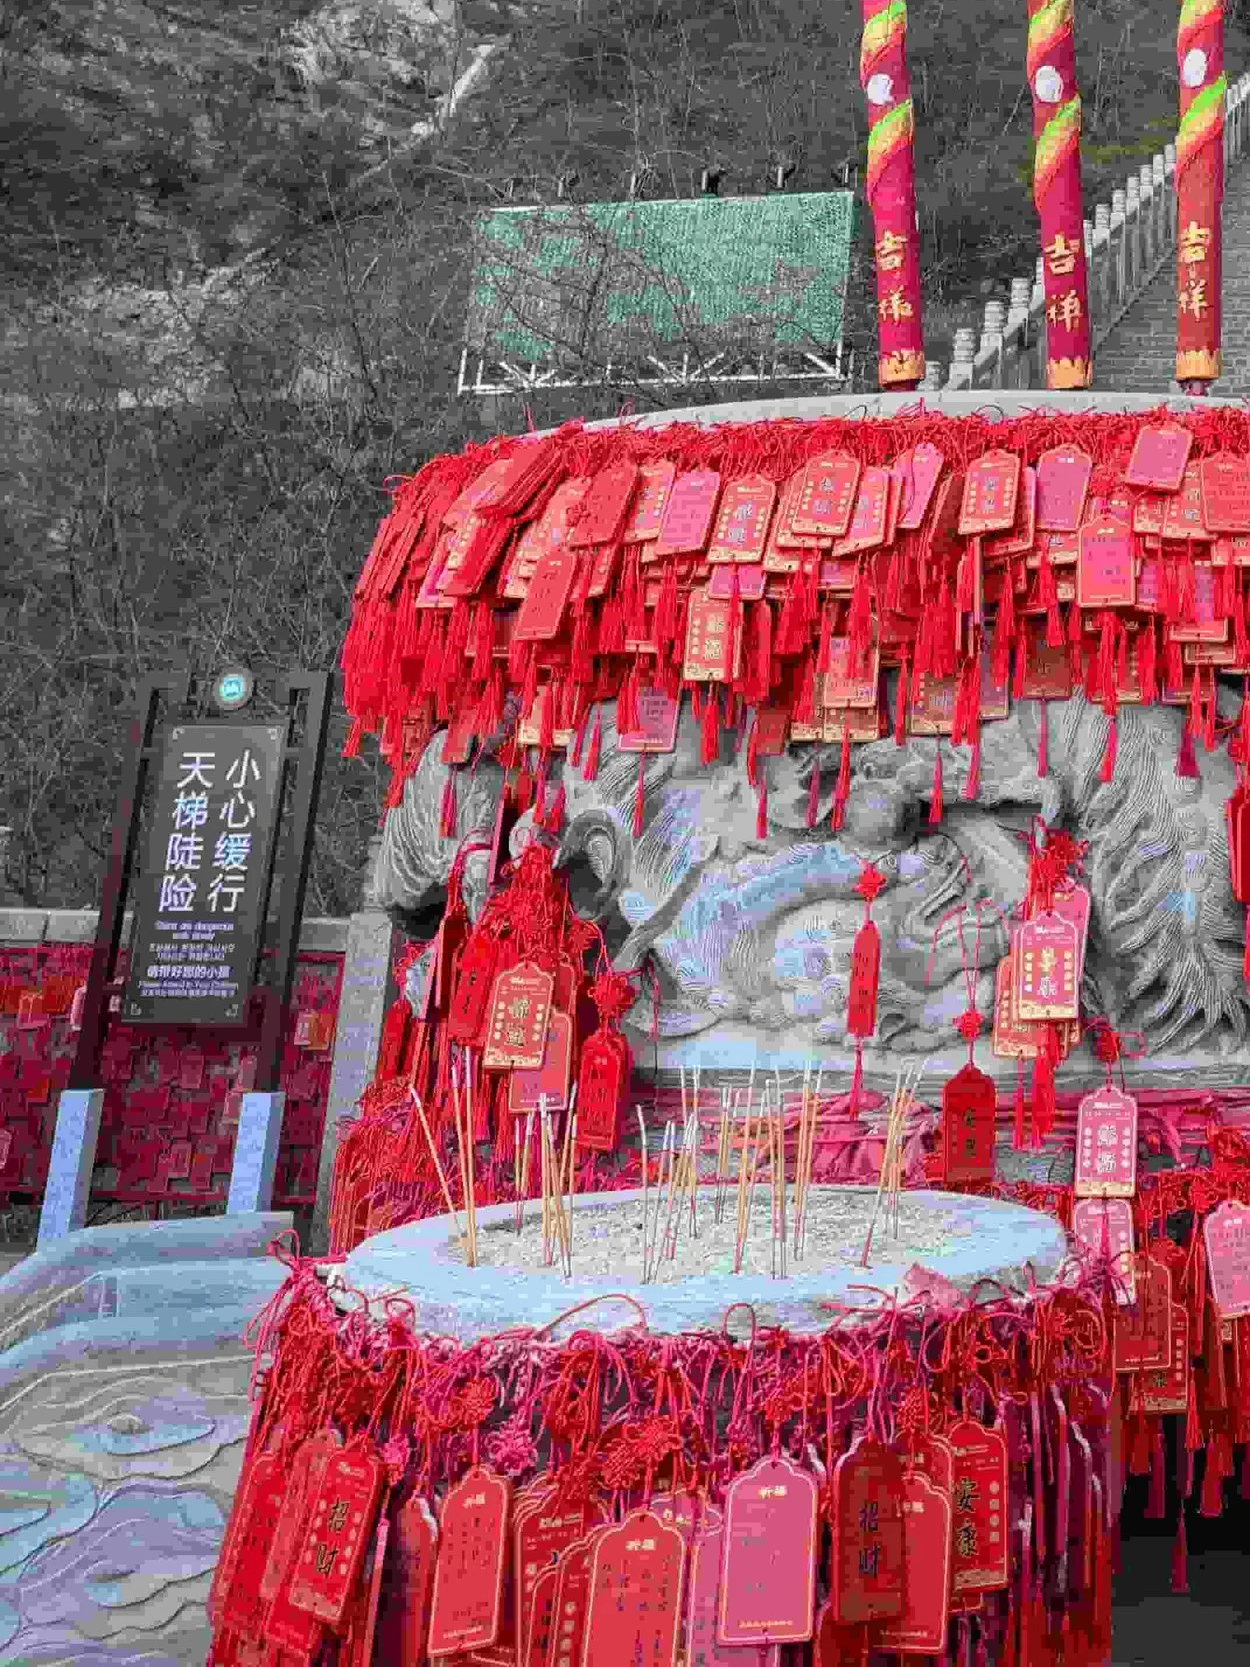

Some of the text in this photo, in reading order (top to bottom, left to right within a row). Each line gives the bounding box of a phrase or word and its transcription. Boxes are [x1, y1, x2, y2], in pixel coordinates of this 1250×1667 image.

[875, 230, 913, 326] 吉祥
[1044, 234, 1082, 332] 吉祥
[1177, 221, 1214, 321] 吉祥
[158, 751, 216, 913] 天梯陡险
[207, 748, 262, 914] 小心缓行
